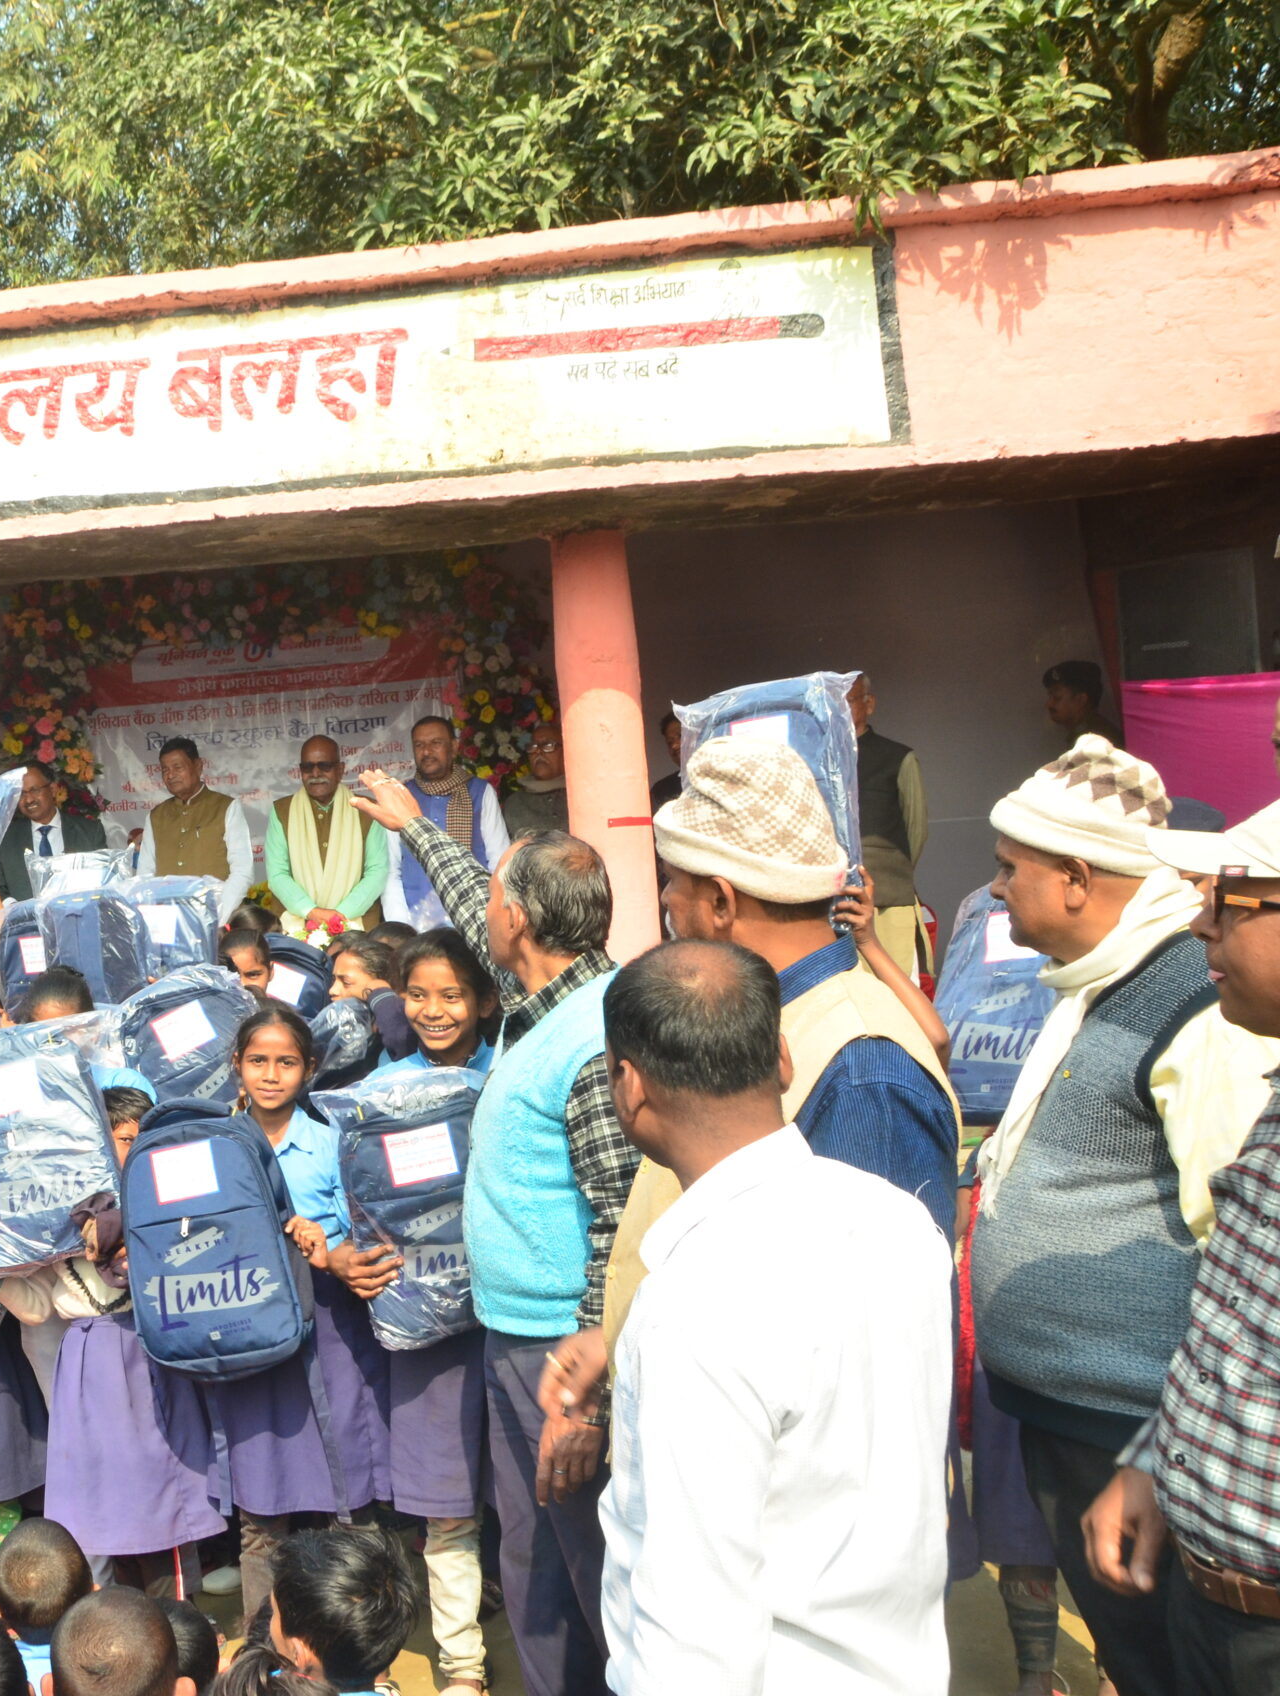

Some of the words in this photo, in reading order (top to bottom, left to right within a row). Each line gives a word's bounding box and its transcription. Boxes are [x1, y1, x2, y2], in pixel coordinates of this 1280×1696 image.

[590, 283, 629, 308] शिक्षा
[167, 326, 409, 433] बलहा
[567, 363, 589, 382] सब
[623, 359, 650, 380] सब
[326, 633, 363, 647] Bank
[87, 712, 130, 735] यूनियन
[159, 1253, 264, 1332] Limits
